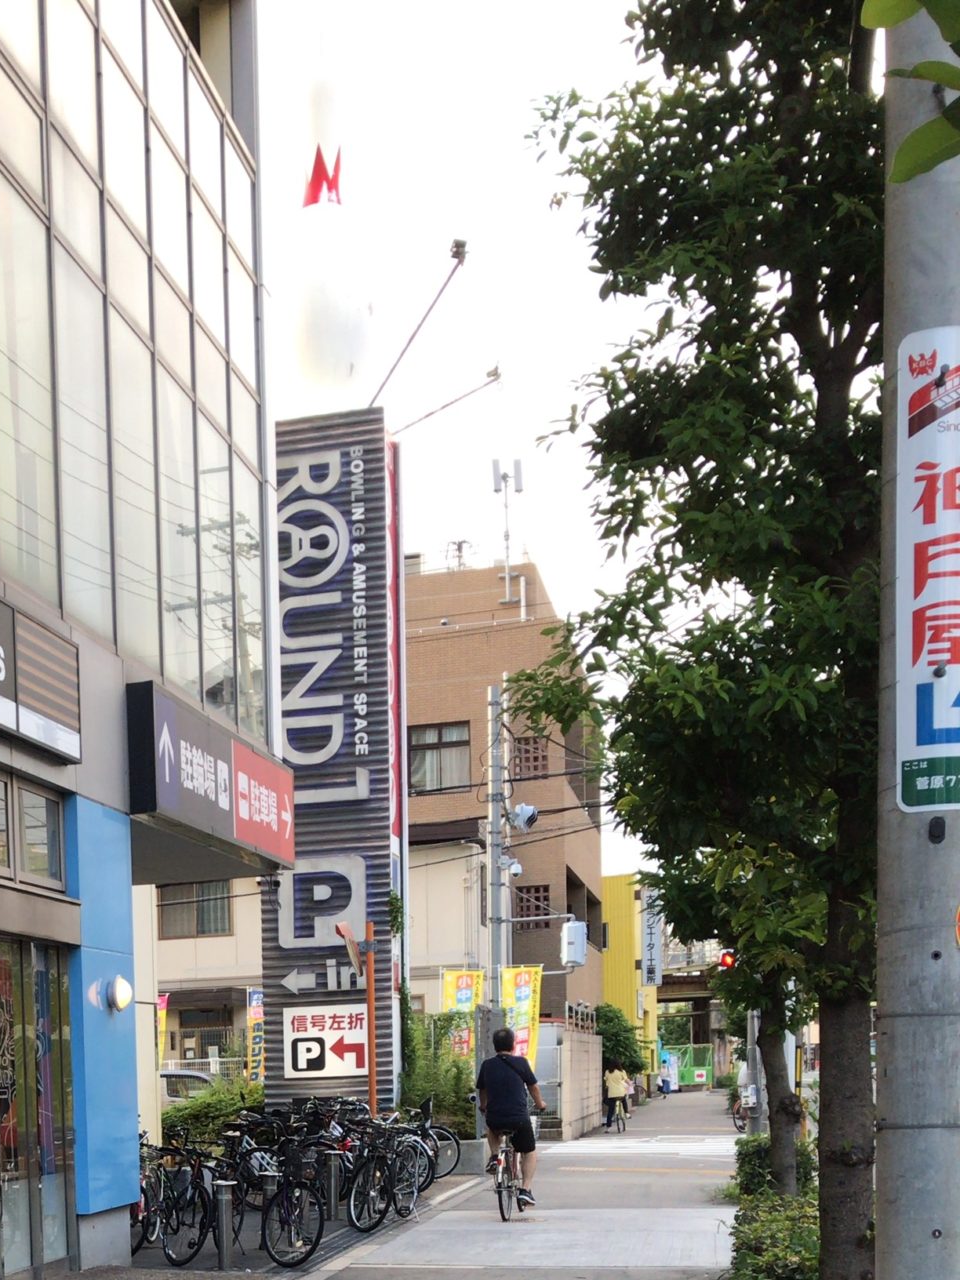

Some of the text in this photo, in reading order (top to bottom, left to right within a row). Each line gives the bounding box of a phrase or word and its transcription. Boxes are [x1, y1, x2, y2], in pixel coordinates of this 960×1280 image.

[350, 445, 370, 756] BOWLING & AMUSEMENT SPACE
[180, 739, 216, 801] 駐輪場
[249, 779, 278, 832] 駐車場
[293, 870, 353, 940] P
[290, 1012, 365, 1033] 信号左折
